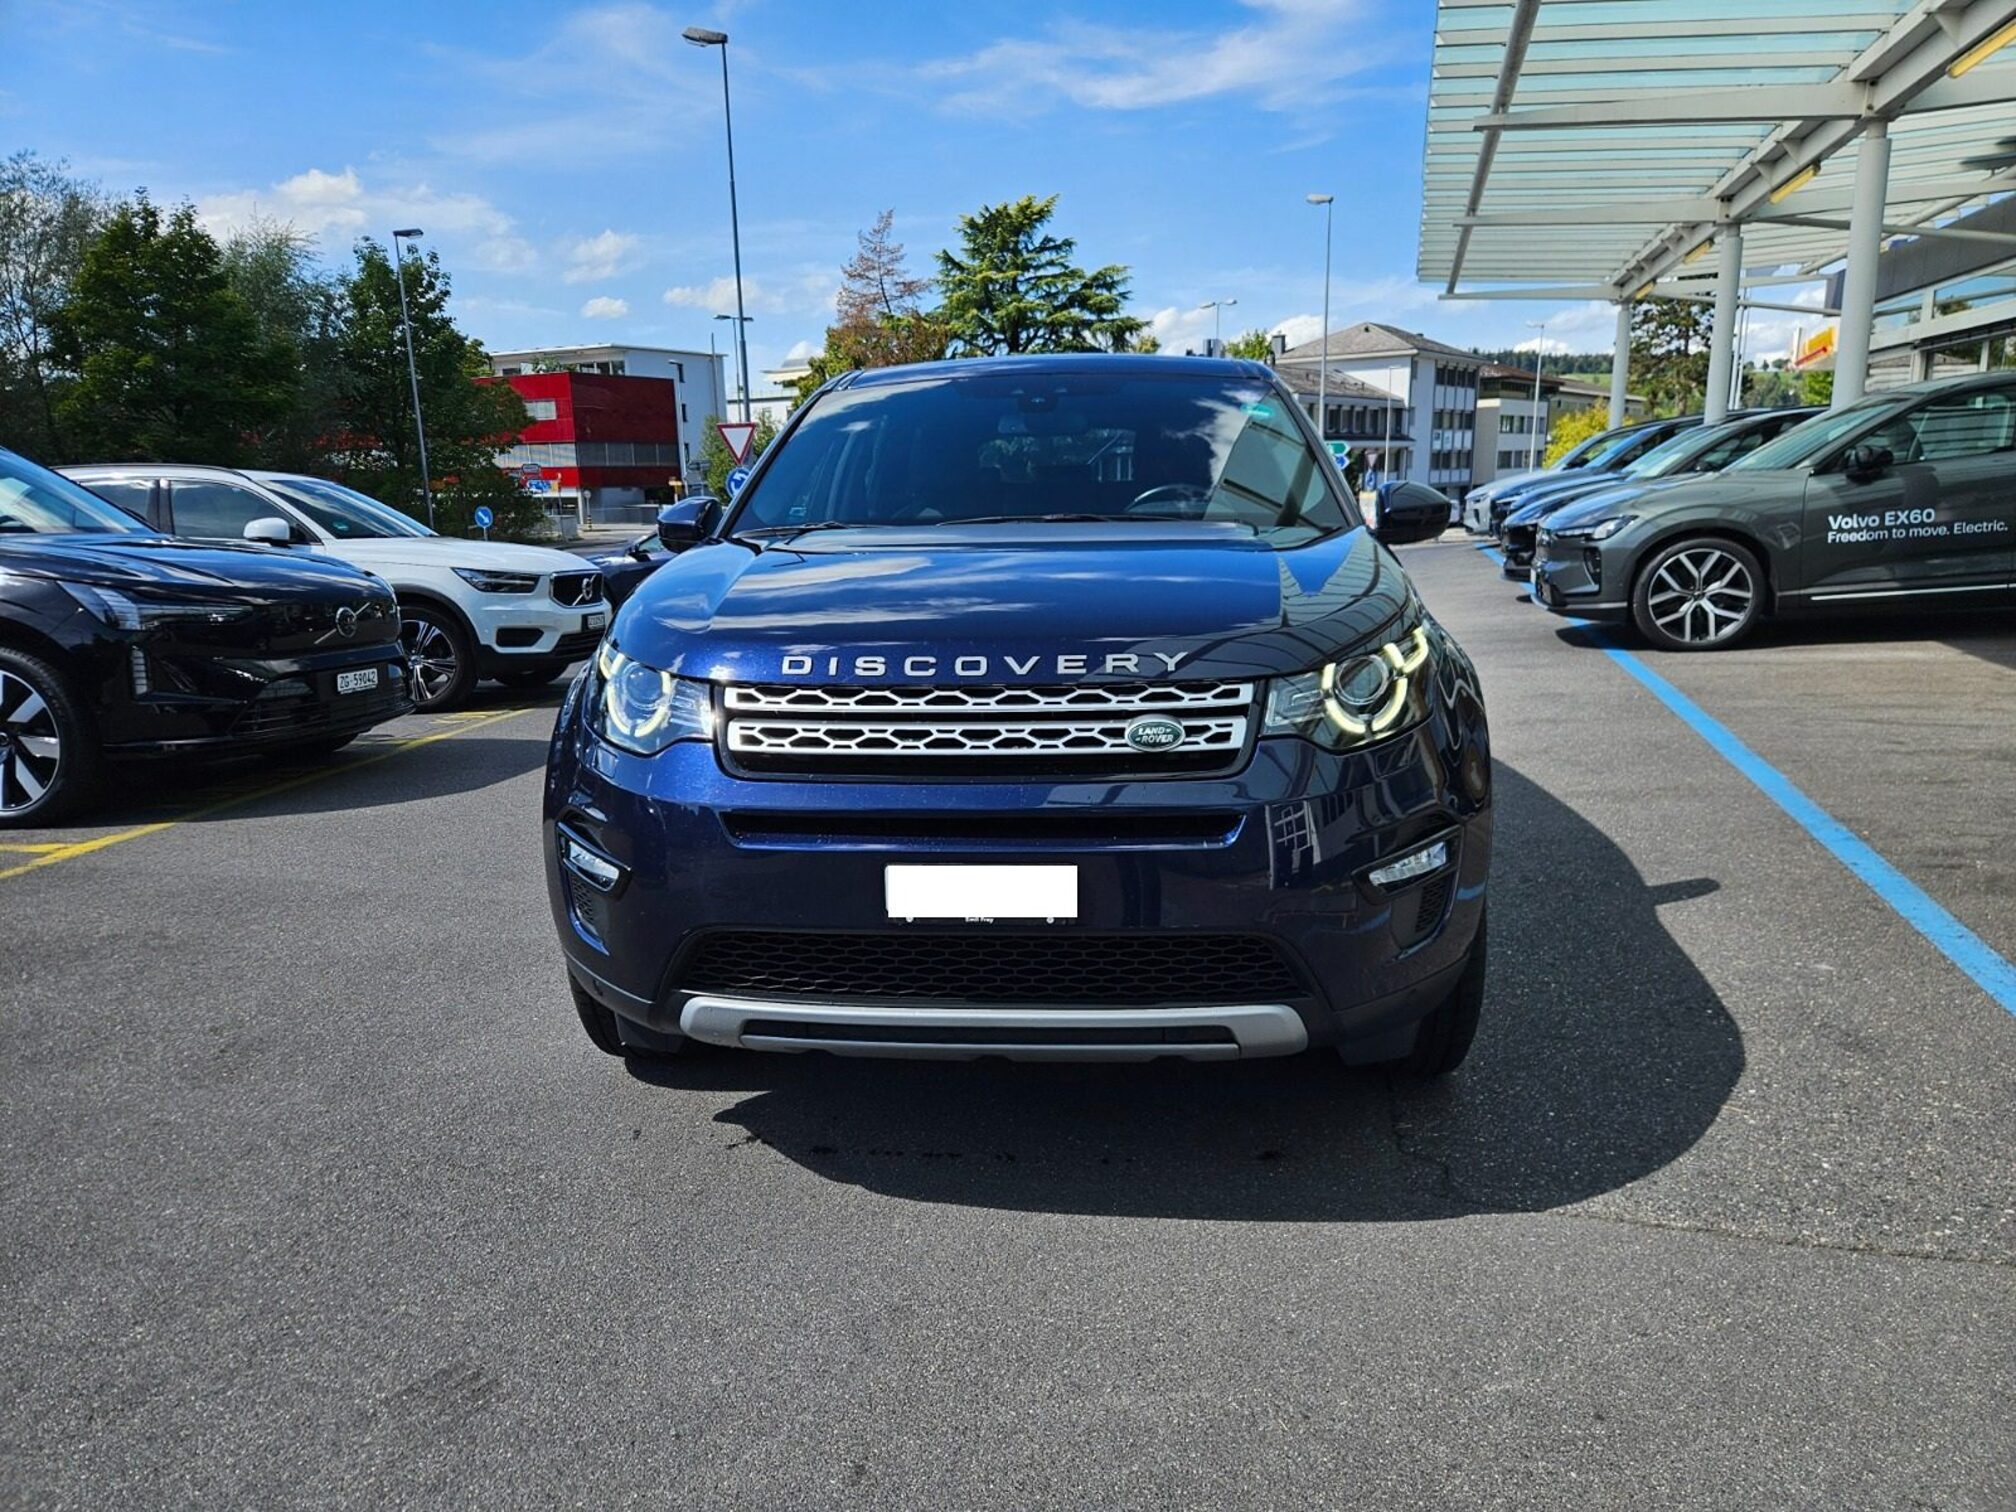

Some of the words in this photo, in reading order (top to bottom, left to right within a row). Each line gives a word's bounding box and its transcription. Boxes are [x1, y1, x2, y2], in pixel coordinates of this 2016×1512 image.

[1828, 513, 1880, 530] Volvo
[1884, 509, 1935, 526] EX60
[1827, 529, 1888, 543] Freedom
[1892, 528, 1906, 539] to
[1909, 526, 1950, 538] move.
[1953, 520, 2008, 535] Electric.
[781, 652, 1188, 676] DISCOVERY
[1138, 727, 1165, 735] LAND
[1141, 734, 1174, 743] ROVER
